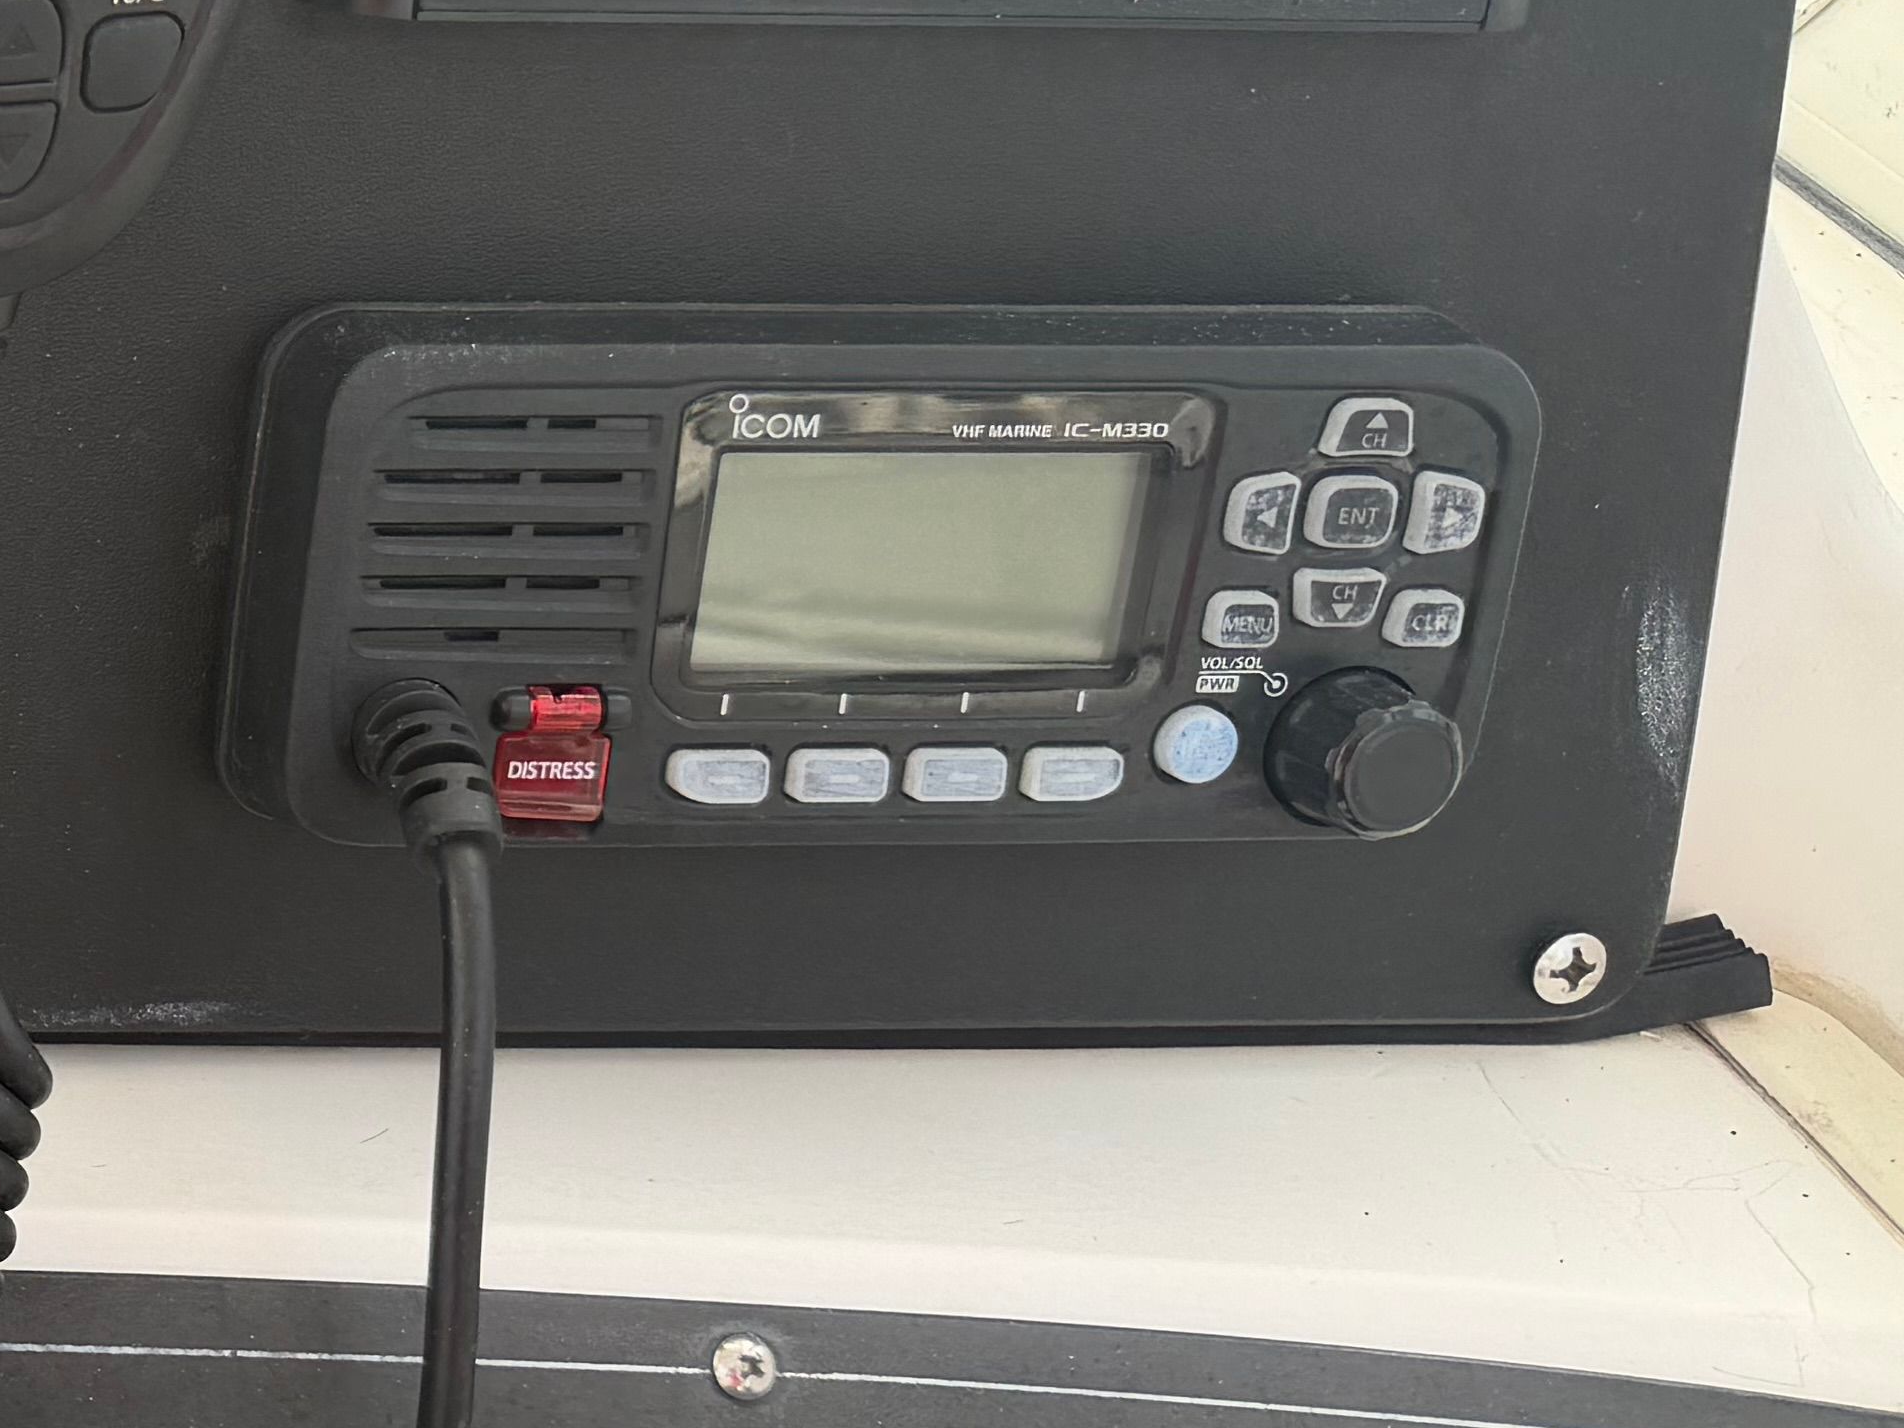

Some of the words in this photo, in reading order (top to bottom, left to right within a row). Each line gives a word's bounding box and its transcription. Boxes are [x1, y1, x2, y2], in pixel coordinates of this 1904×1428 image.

[952, 425, 985, 438] VHF
[989, 425, 1052, 438] MARINE
[1064, 423, 1169, 438] IC-M330
[1361, 433, 1387, 448] CH
[1338, 507, 1379, 526] ENT
[1332, 585, 1357, 600] CH
[1222, 615, 1273, 633] MENU
[1412, 615, 1447, 632] CLR
[1201, 657, 1264, 669] VOL/SQL
[1199, 678, 1235, 690] PWR
[507, 761, 597, 780] DISTRESS
